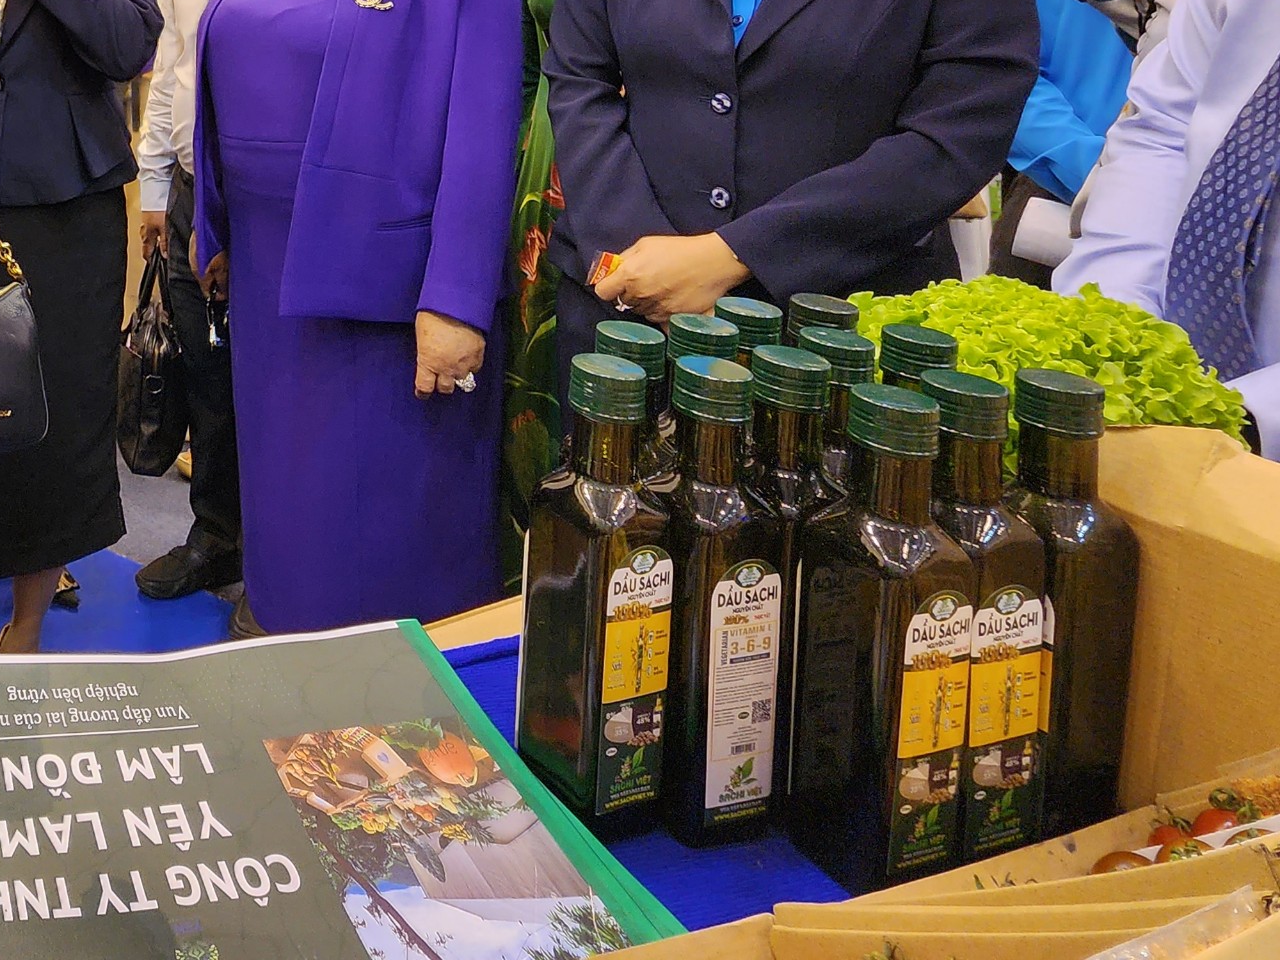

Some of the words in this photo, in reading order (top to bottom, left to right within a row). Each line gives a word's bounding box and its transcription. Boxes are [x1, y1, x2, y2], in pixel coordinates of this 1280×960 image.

[639, 570, 670, 592] SACHI
[744, 585, 778, 604] SACHI
[939, 617, 970, 639] SACHI
[1005, 611, 1039, 632] SACHI
[730, 636, 772, 655] 3-6-9
[6, 686, 50, 704] vững
[51, 686, 82, 704] bền
[84, 683, 139, 701] nghiệp
[13, 711, 42, 730] của
[45, 711, 67, 727] lai
[68, 707, 119, 725] tương
[122, 705, 152, 727] đắp
[154, 704, 190, 720] Vun
[115, 742, 215, 784] LÂM
[121, 800, 232, 848] YÊN
[164, 853, 301, 906] CÔNG
[96, 870, 158, 916] TY
